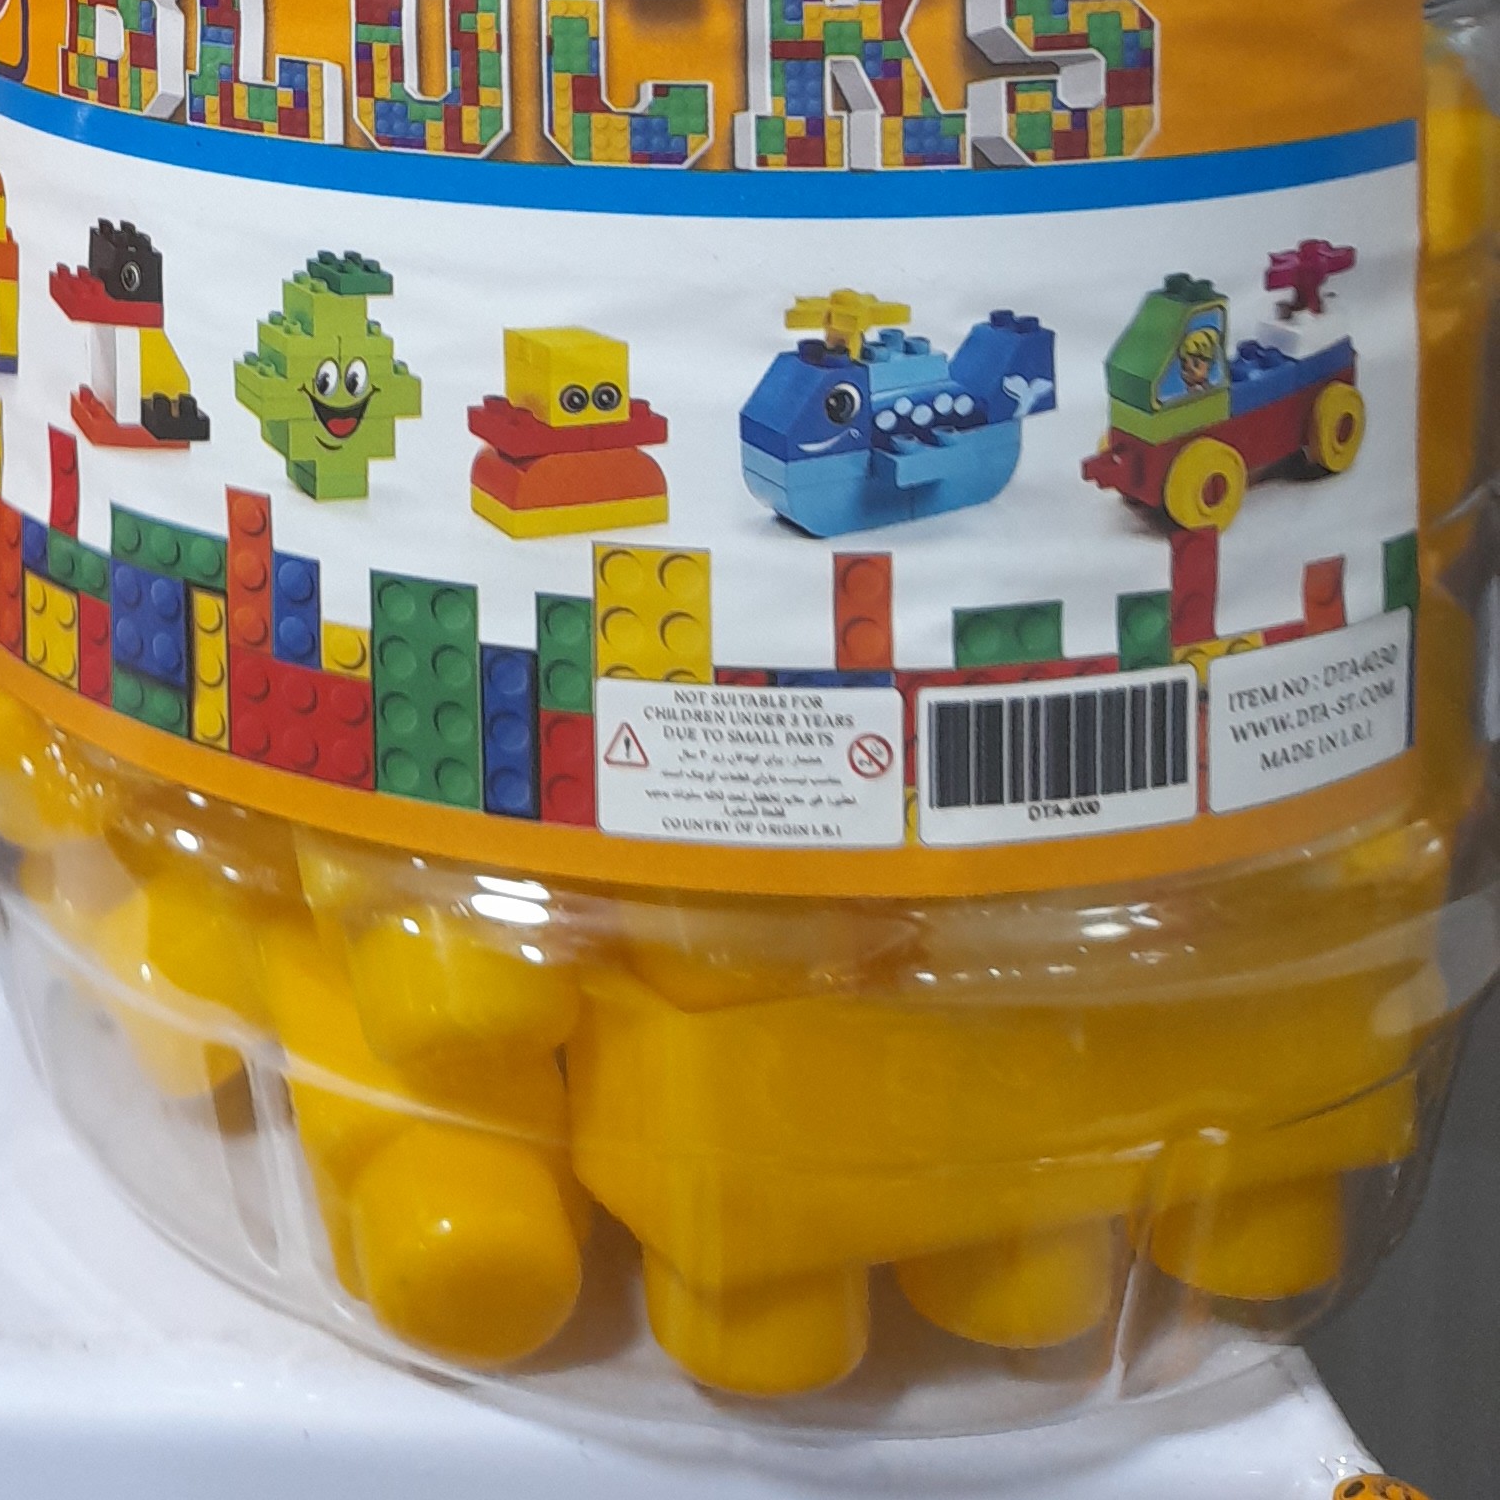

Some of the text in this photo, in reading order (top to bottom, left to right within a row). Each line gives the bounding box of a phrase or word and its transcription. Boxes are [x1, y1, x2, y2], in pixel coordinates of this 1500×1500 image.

[673, 689, 823, 710] NOT SUITABLE FOR
[1228, 684, 1278, 713] ITEM
[643, 704, 726, 726] CHILDREN
[728, 710, 786, 728] UNDER
[801, 712, 855, 729] YEARS
[663, 725, 835, 747] DUE TO SMALL PARTS
[1260, 738, 1315, 772] MADE
[661, 816, 731, 833] COUNTRY
[756, 821, 810, 837] ORIGIN
